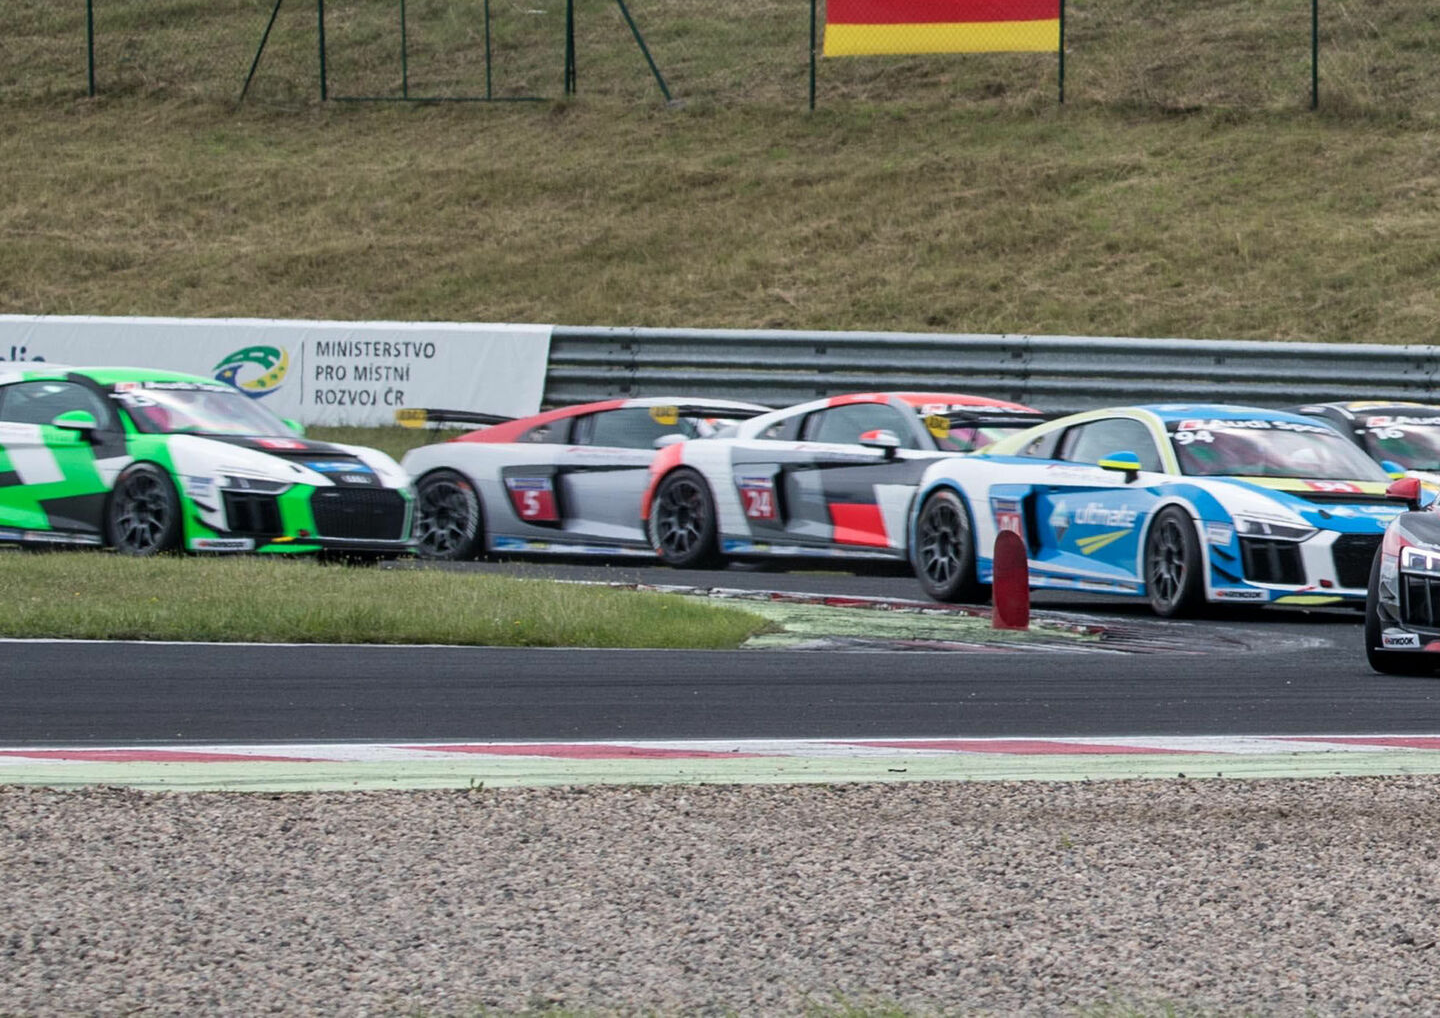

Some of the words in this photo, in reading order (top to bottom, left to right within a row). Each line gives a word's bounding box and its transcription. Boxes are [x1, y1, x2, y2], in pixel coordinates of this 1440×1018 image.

[316, 341, 436, 359] MINISTERSTVO
[315, 365, 346, 381] PRO
[353, 362, 410, 381] MÍSTNÍ
[315, 389, 377, 406] ROZVOJ
[384, 386, 405, 406] ČR
[1175, 430, 1215, 445] 94
[522, 490, 541, 516] 5
[747, 488, 772, 517] 24
